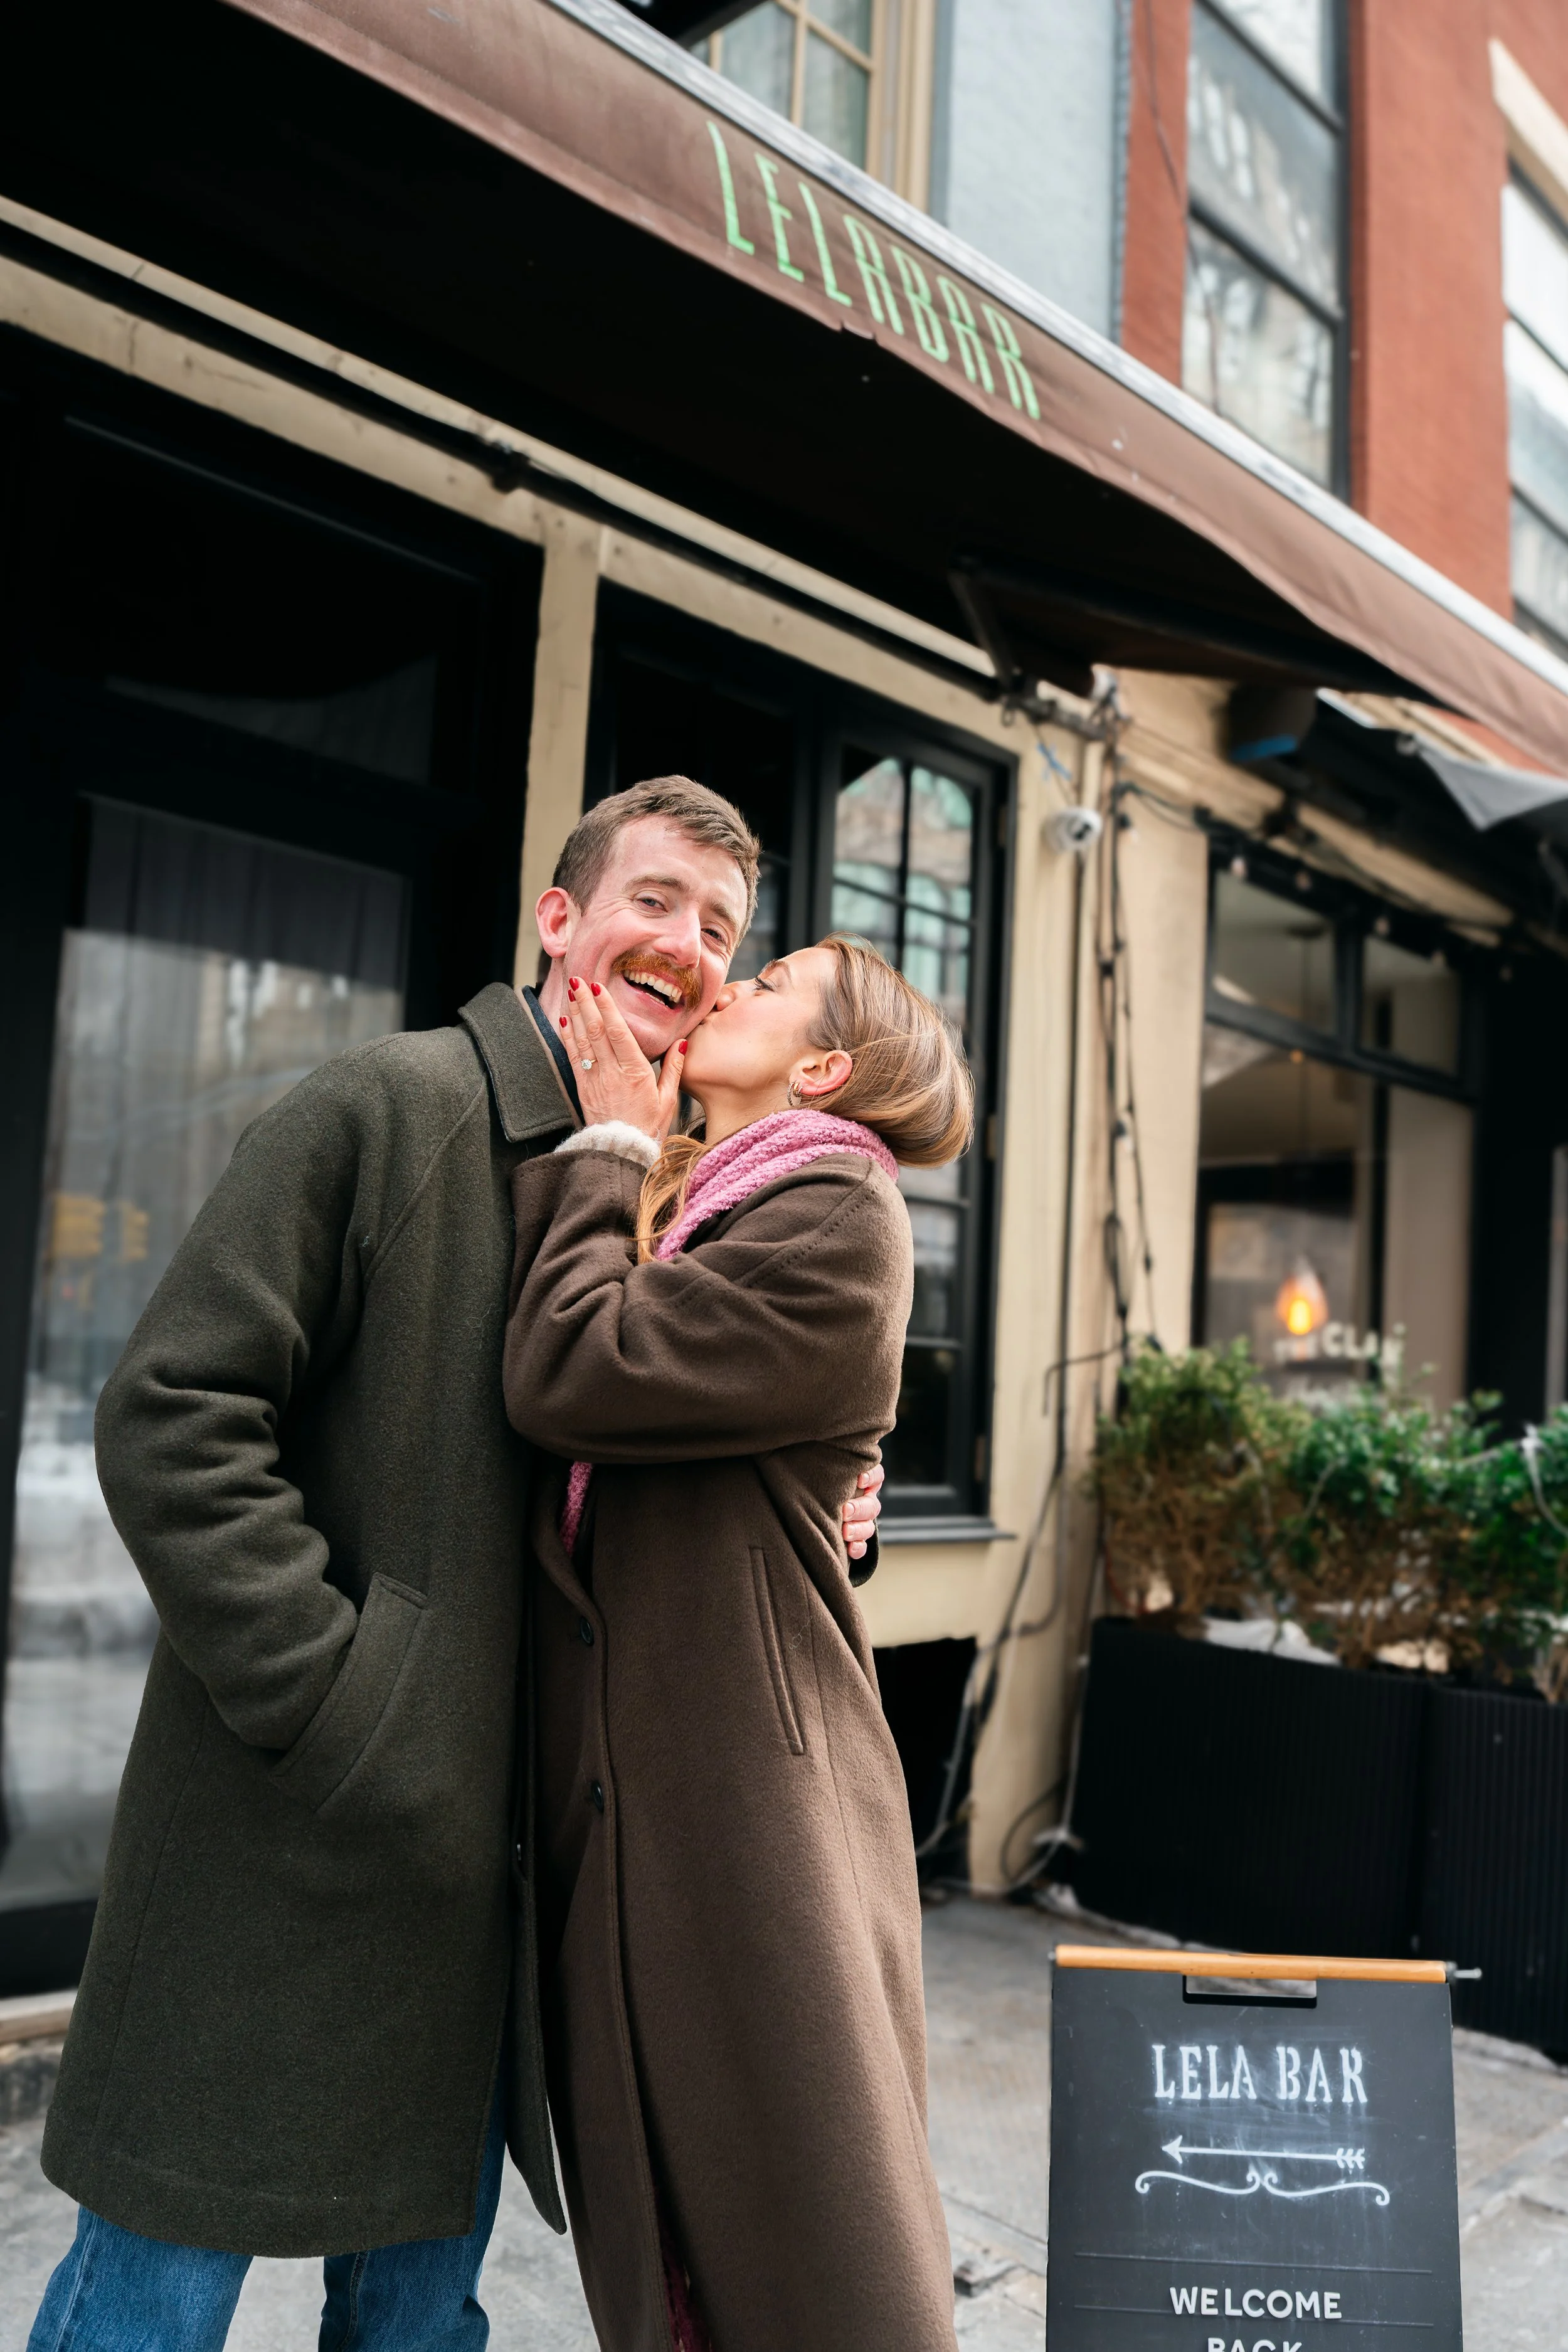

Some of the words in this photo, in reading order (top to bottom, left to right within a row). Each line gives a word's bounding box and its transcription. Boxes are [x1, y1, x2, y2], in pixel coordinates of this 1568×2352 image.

[1152, 2044, 1258, 2100] LELA
[1276, 2045, 1369, 2104] BAR
[1169, 2286, 1342, 2319] WELCOME
